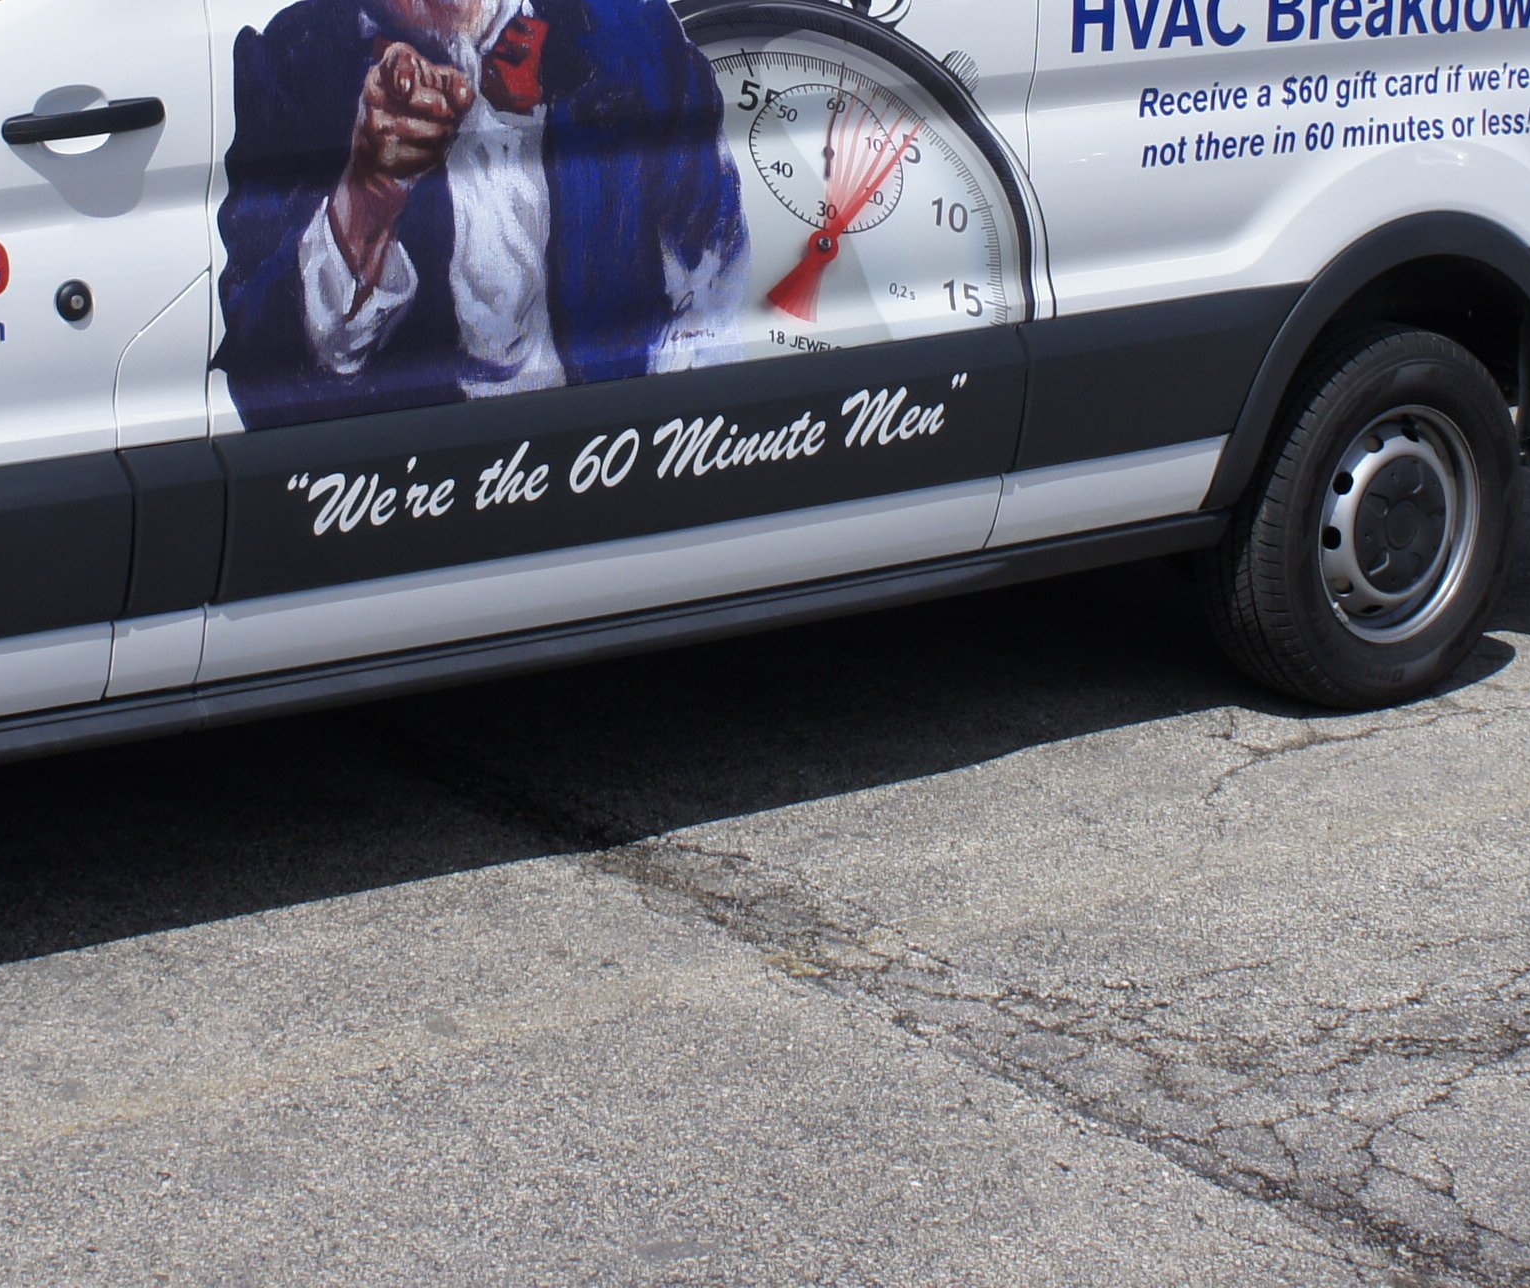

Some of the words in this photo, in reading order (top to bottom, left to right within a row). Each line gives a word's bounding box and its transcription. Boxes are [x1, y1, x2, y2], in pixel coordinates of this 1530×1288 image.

[1138, 81, 1248, 119] Receive
[1257, 84, 1272, 107] a
[1281, 73, 1328, 110] $60
[1335, 69, 1378, 110] gift
[1384, 66, 1438, 97] card
[1446, 63, 1463, 91] if
[776, 103, 798, 123] 50
[1140, 131, 1187, 169] not
[1194, 127, 1265, 164] there
[1272, 124, 1296, 155] in
[1304, 121, 1335, 152] 60
[1342, 111, 1445, 149] minutes
[1451, 114, 1475, 139] or
[770, 160, 794, 179] 40
[816, 200, 838, 221] 30
[930, 196, 969, 234] 10
[942, 278, 984, 318] 15
[768, 329, 786, 345] 18
[474, 439, 550, 511] the
[569, 434, 640, 495] 60
[652, 410, 827, 480] Minute
